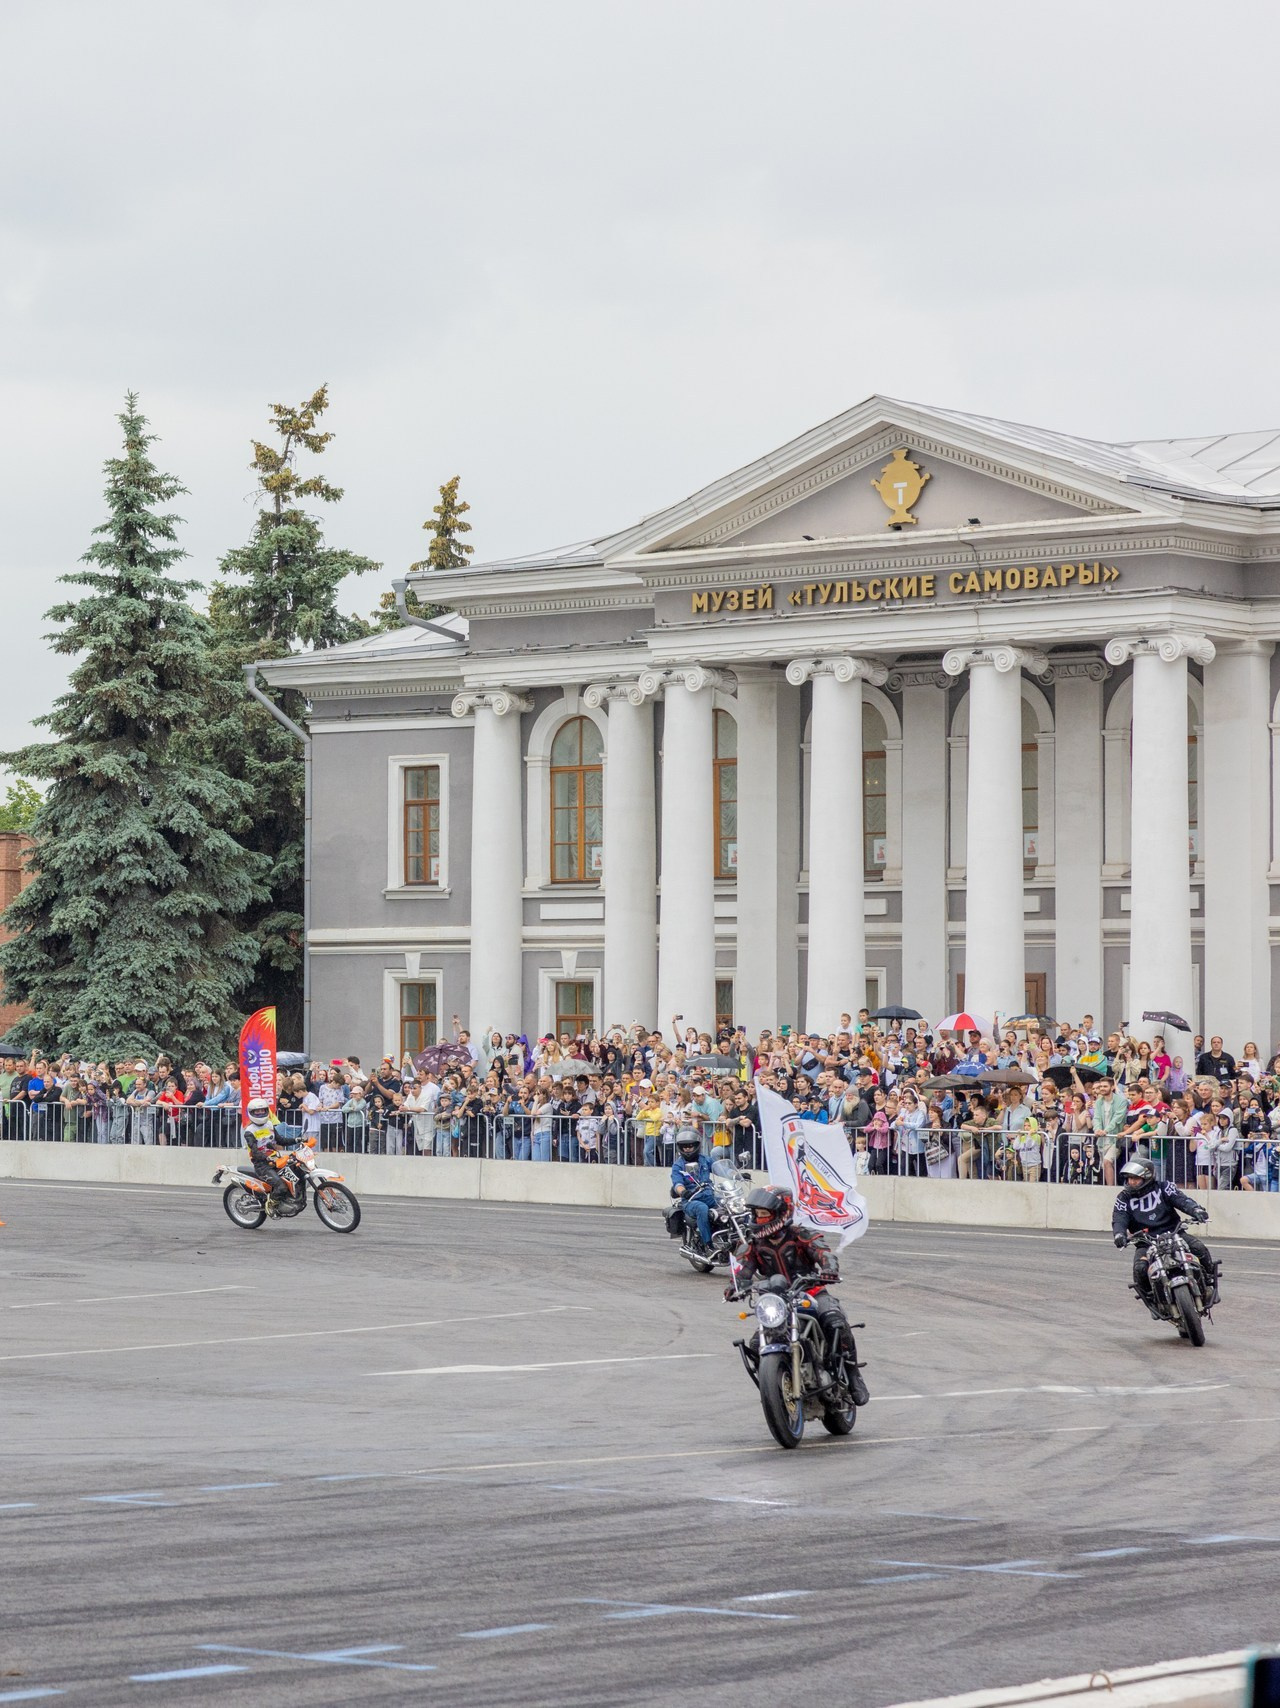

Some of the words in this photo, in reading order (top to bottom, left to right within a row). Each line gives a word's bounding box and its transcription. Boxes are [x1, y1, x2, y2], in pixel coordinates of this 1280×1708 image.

[691, 586, 773, 613] МУЗЕЙ
[787, 574, 936, 606] «ТУЛЬСКИЕ
[948, 562, 1120, 594] САМОВАРЫ»
[248, 1066, 261, 1098] ЛЬФА
[1130, 1188, 1161, 1212] FOX
